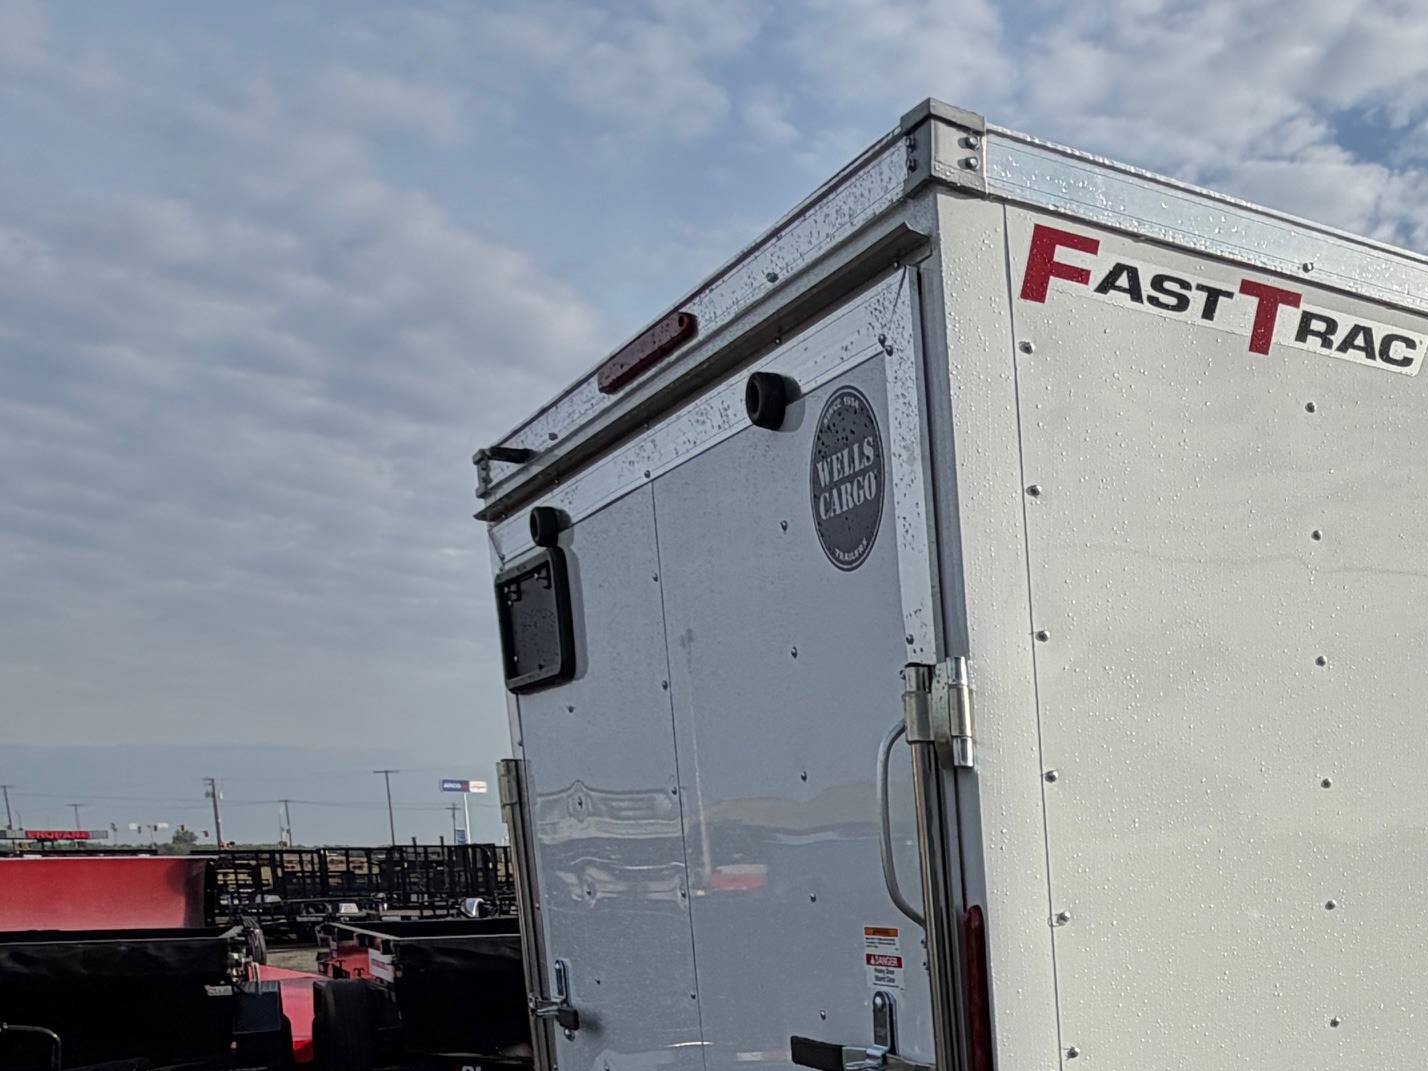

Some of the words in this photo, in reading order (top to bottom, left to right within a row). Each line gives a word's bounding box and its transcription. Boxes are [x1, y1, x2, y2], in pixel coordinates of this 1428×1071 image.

[816, 435, 875, 489] WELLS
[819, 471, 877, 521] CARGO
[875, 955, 898, 967] DANGER
